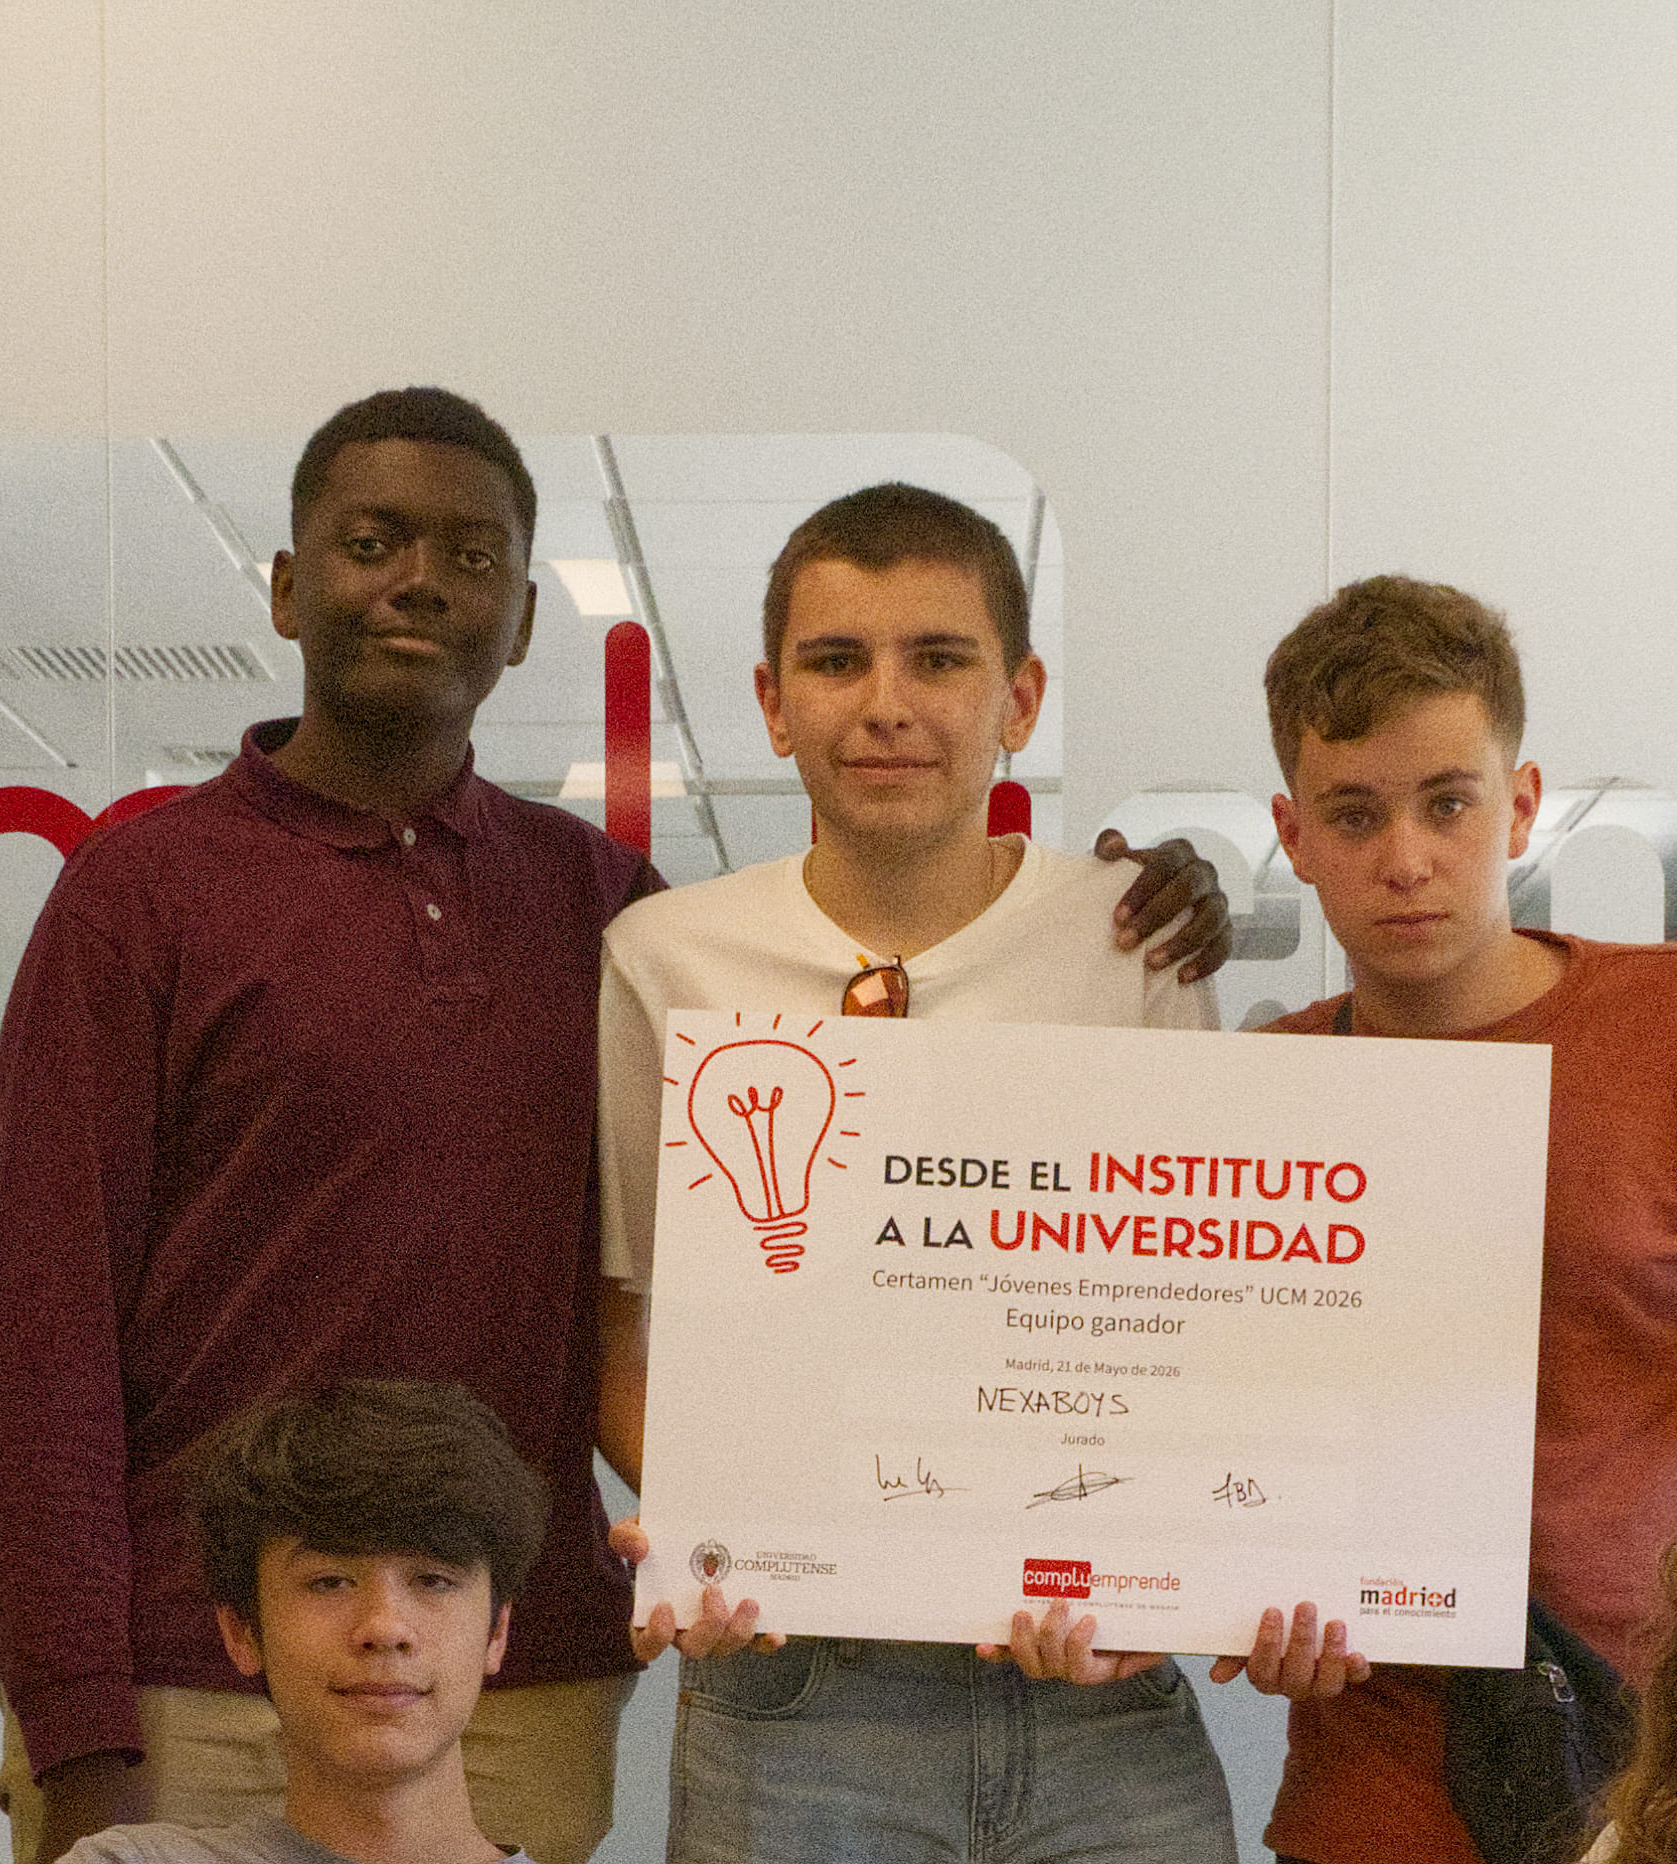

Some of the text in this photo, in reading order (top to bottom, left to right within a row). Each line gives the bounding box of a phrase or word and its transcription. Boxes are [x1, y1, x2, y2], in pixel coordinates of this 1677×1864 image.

[883, 1152, 1368, 1204] DESDE EL INSTITUTO
[875, 1209, 1366, 1265] A LA UNIVERSIDAD
[871, 1269, 1363, 1309] Certamen “Jóvenes Emprendedores” UCM 2026
[1006, 1308, 1187, 1338] Equipo ganador
[1005, 1357, 1181, 1378] Madrid, 21 de Mayo de 2026
[977, 1386, 1130, 1418] NEXABOYS
[1060, 1432, 1106, 1447] Jurado
[734, 1559, 838, 1576] COMPLUTENSE
